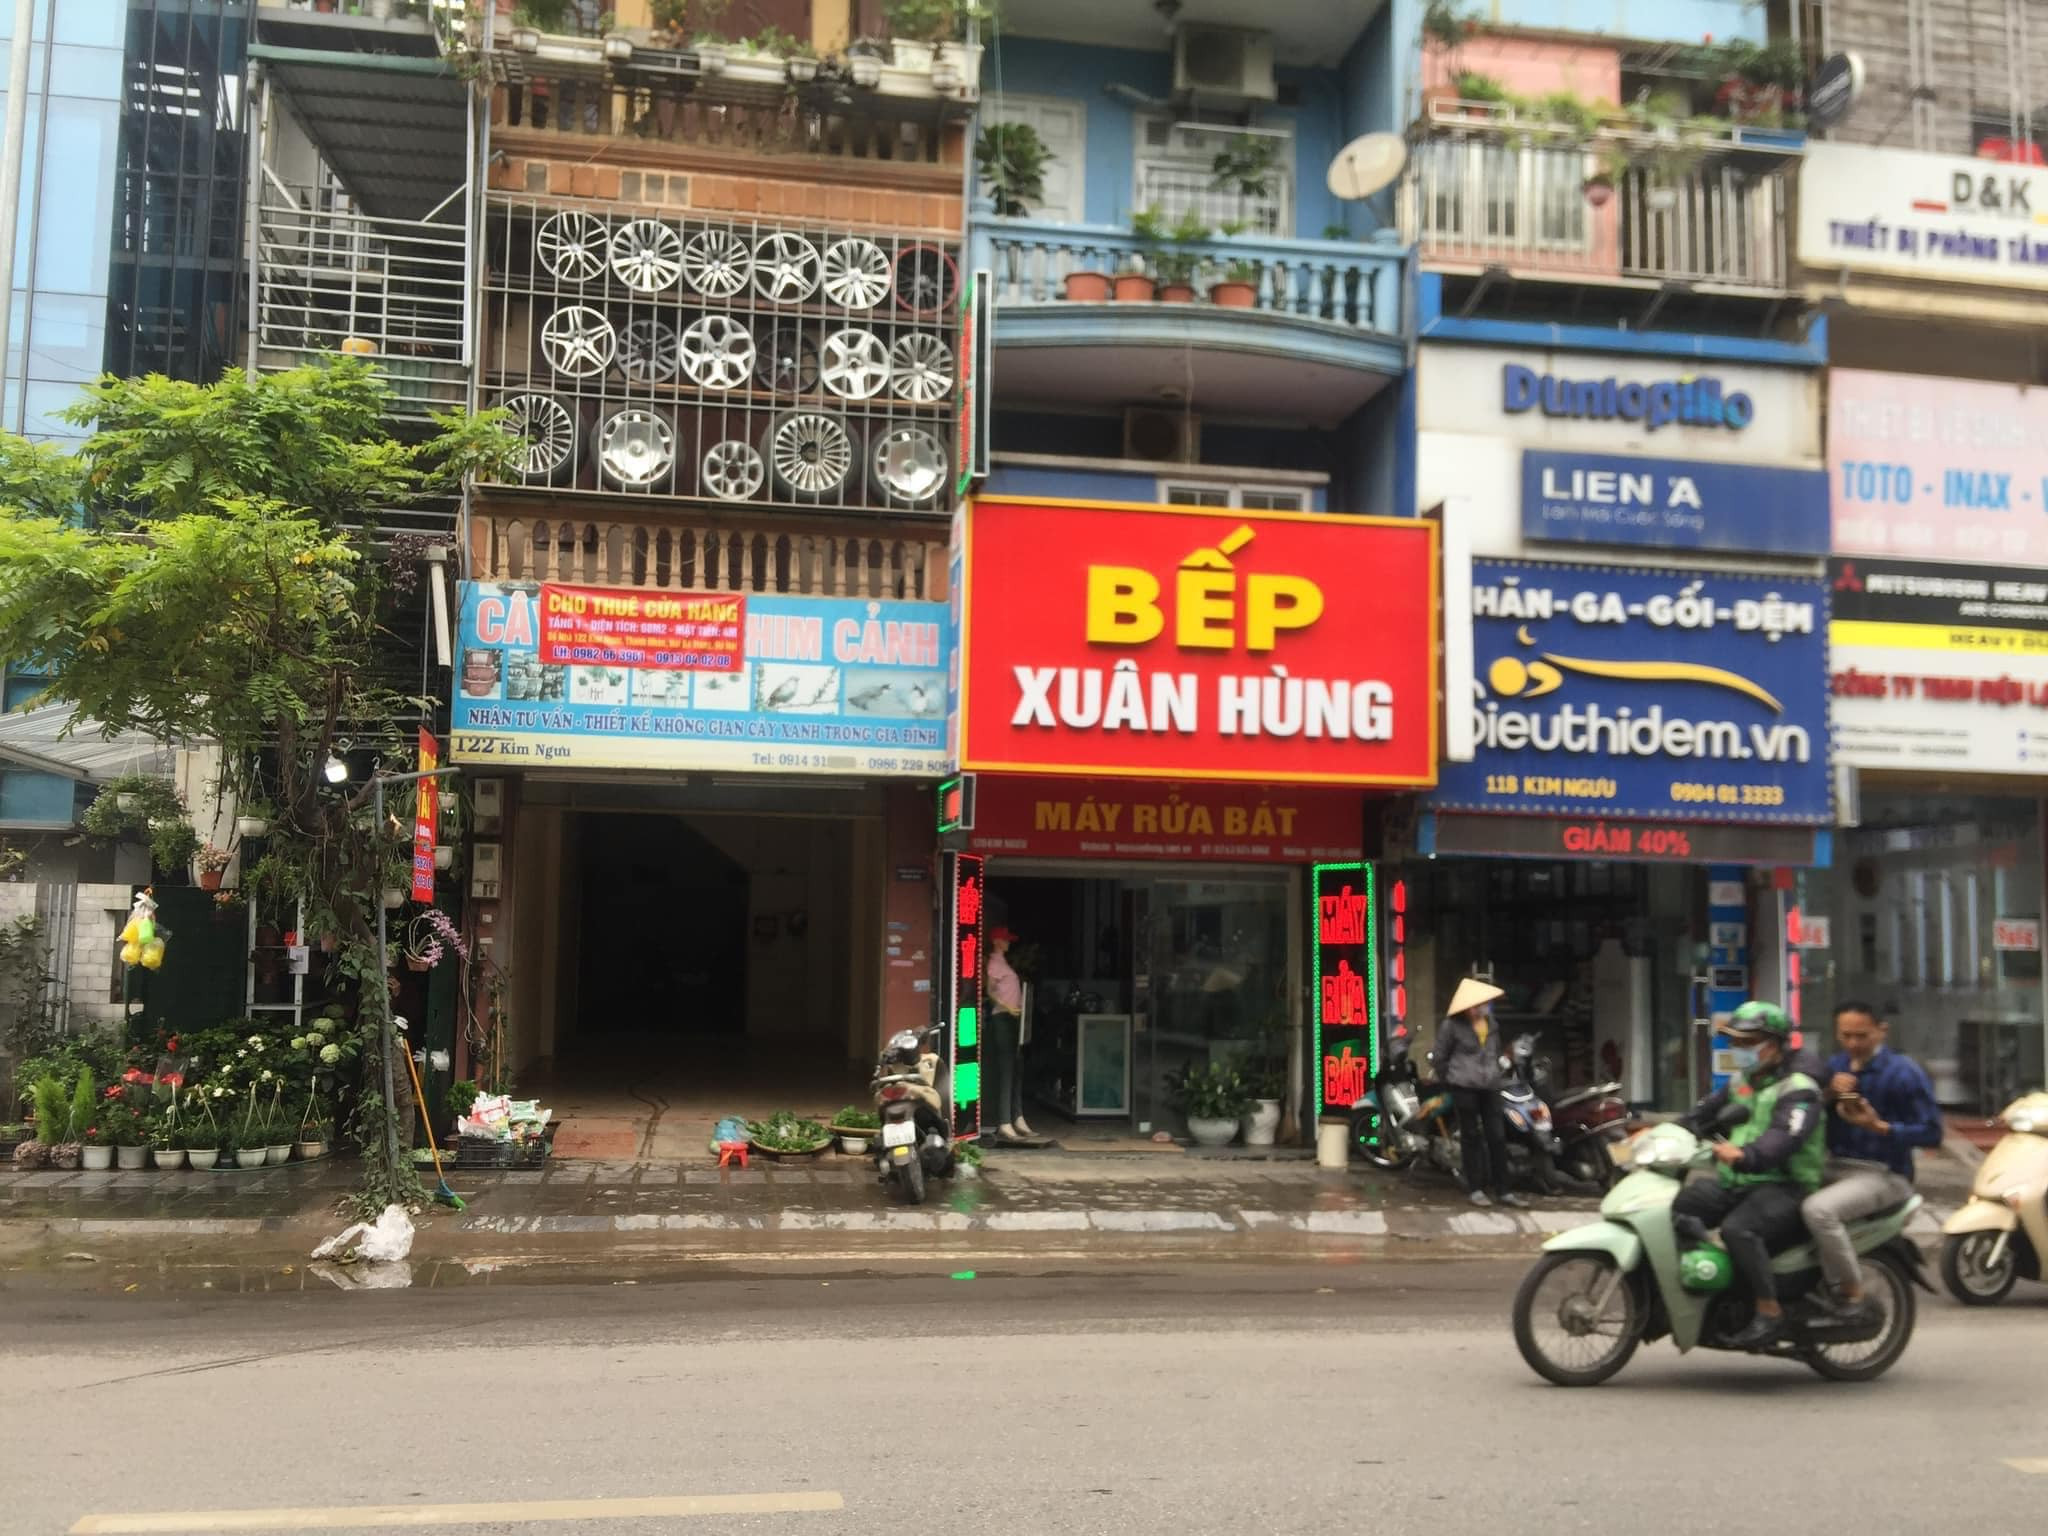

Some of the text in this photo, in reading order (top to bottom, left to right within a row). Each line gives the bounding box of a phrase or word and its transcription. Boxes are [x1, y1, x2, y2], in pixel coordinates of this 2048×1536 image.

[1542, 467, 1653, 504] LIEN
[1841, 461, 1912, 503] TOTO
[1944, 469, 2011, 510] INAX
[1086, 524, 1324, 651] BẾP
[548, 594, 738, 622] CHO THUÊ CỬA HÀNG
[476, 591, 540, 645] CÂ
[834, 602, 940, 667] CẢNH
[553, 645, 570, 659] LH:
[1011, 658, 1393, 740] XUÂN HÙNG
[468, 706, 512, 729] NHẬN
[516, 710, 537, 727] TƯ
[541, 705, 573, 729] VẤN
[584, 708, 626, 732] THIẾT
[631, 707, 651, 732] KẾ
[653, 710, 705, 736] KHÔNG
[709, 720, 745, 737] GIAN
[748, 716, 779, 738] CÂY
[782, 722, 820, 740] XANH
[824, 724, 871, 742] TRONG
[875, 727, 900, 744] GIA
[903, 723, 938, 745] ĐÌNH
[455, 736, 571, 760] 122 Kim Ngưu
[752, 752, 775, 766] Tel:
[778, 753, 808, 768] 0914
[1523, 775, 1561, 796] KIM
[1035, 795, 1299, 837] MÁY RỬA BÁT
[1563, 821, 1692, 856] GIẢM 40%
[1319, 885, 1368, 944] MÁY
